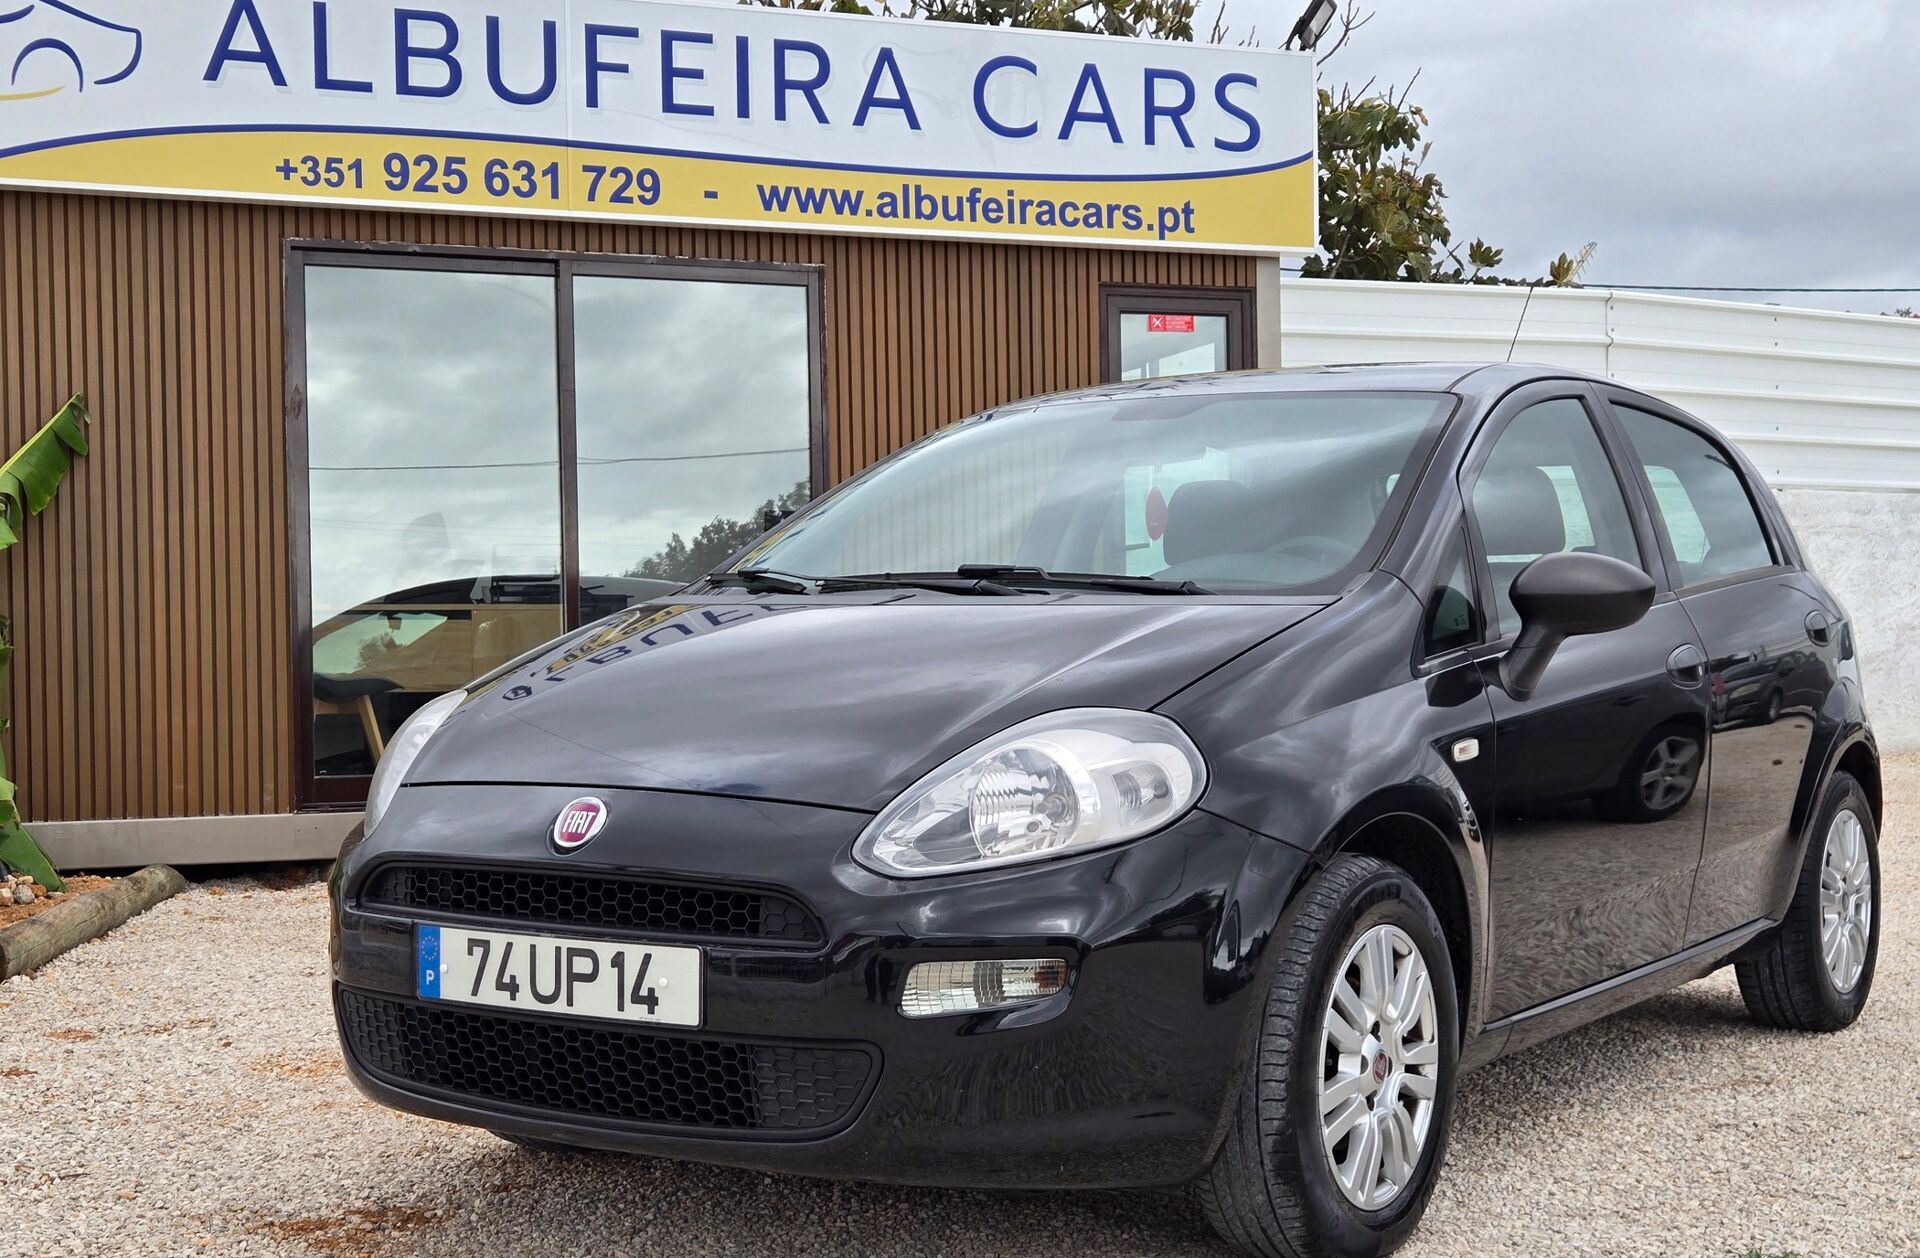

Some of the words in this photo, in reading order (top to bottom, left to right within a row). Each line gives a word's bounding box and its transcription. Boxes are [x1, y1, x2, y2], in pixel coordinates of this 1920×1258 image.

[202, 0, 922, 131] ALBUFEIRA
[973, 55, 1261, 153] CARS
[275, 155, 364, 189] +351
[383, 152, 468, 194] 925
[484, 159, 561, 199] 631
[581, 164, 661, 206] 729
[756, 184, 1195, 241] www.albufeiracars.pt
[562, 810, 597, 834] FIAT
[425, 969, 435, 985] P
